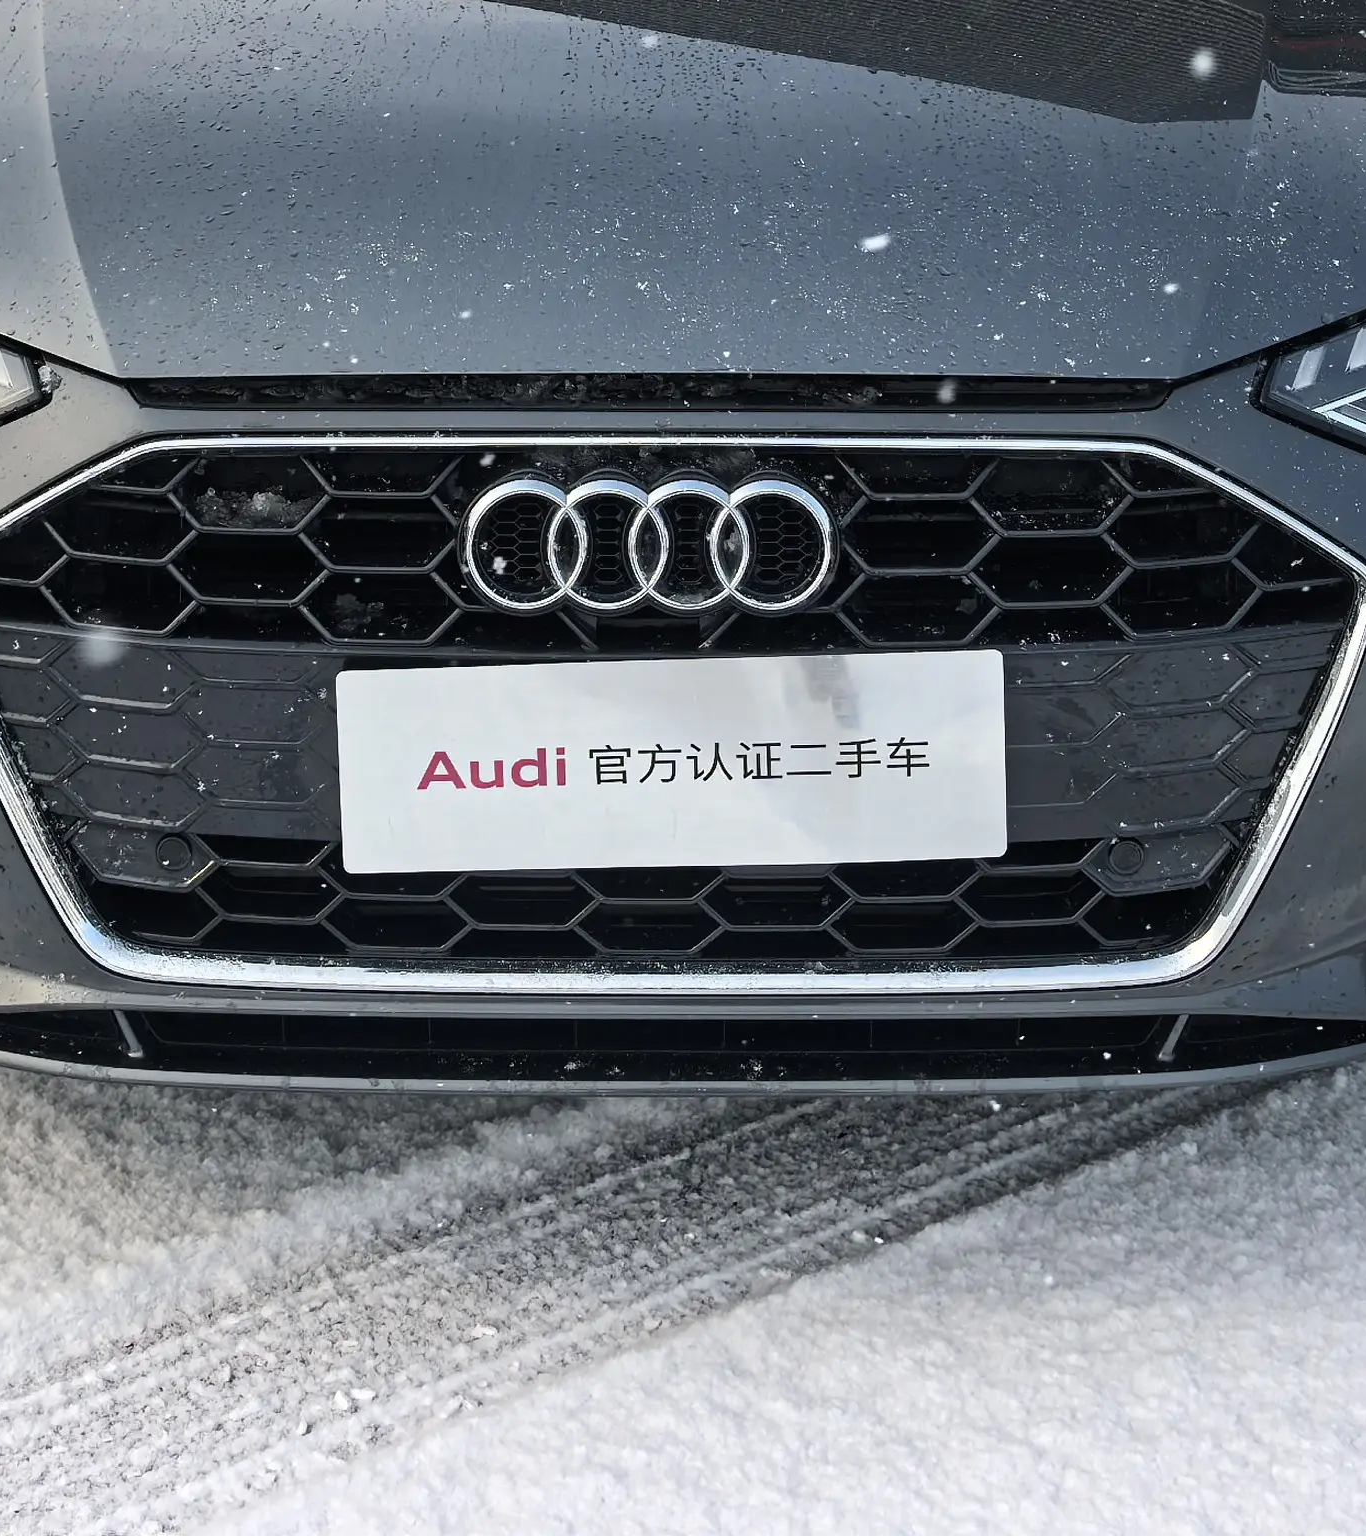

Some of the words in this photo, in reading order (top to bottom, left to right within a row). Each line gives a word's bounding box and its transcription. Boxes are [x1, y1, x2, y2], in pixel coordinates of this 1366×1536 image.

[417, 747, 566, 790] Audi
[588, 737, 930, 785] 官方认证二手车
